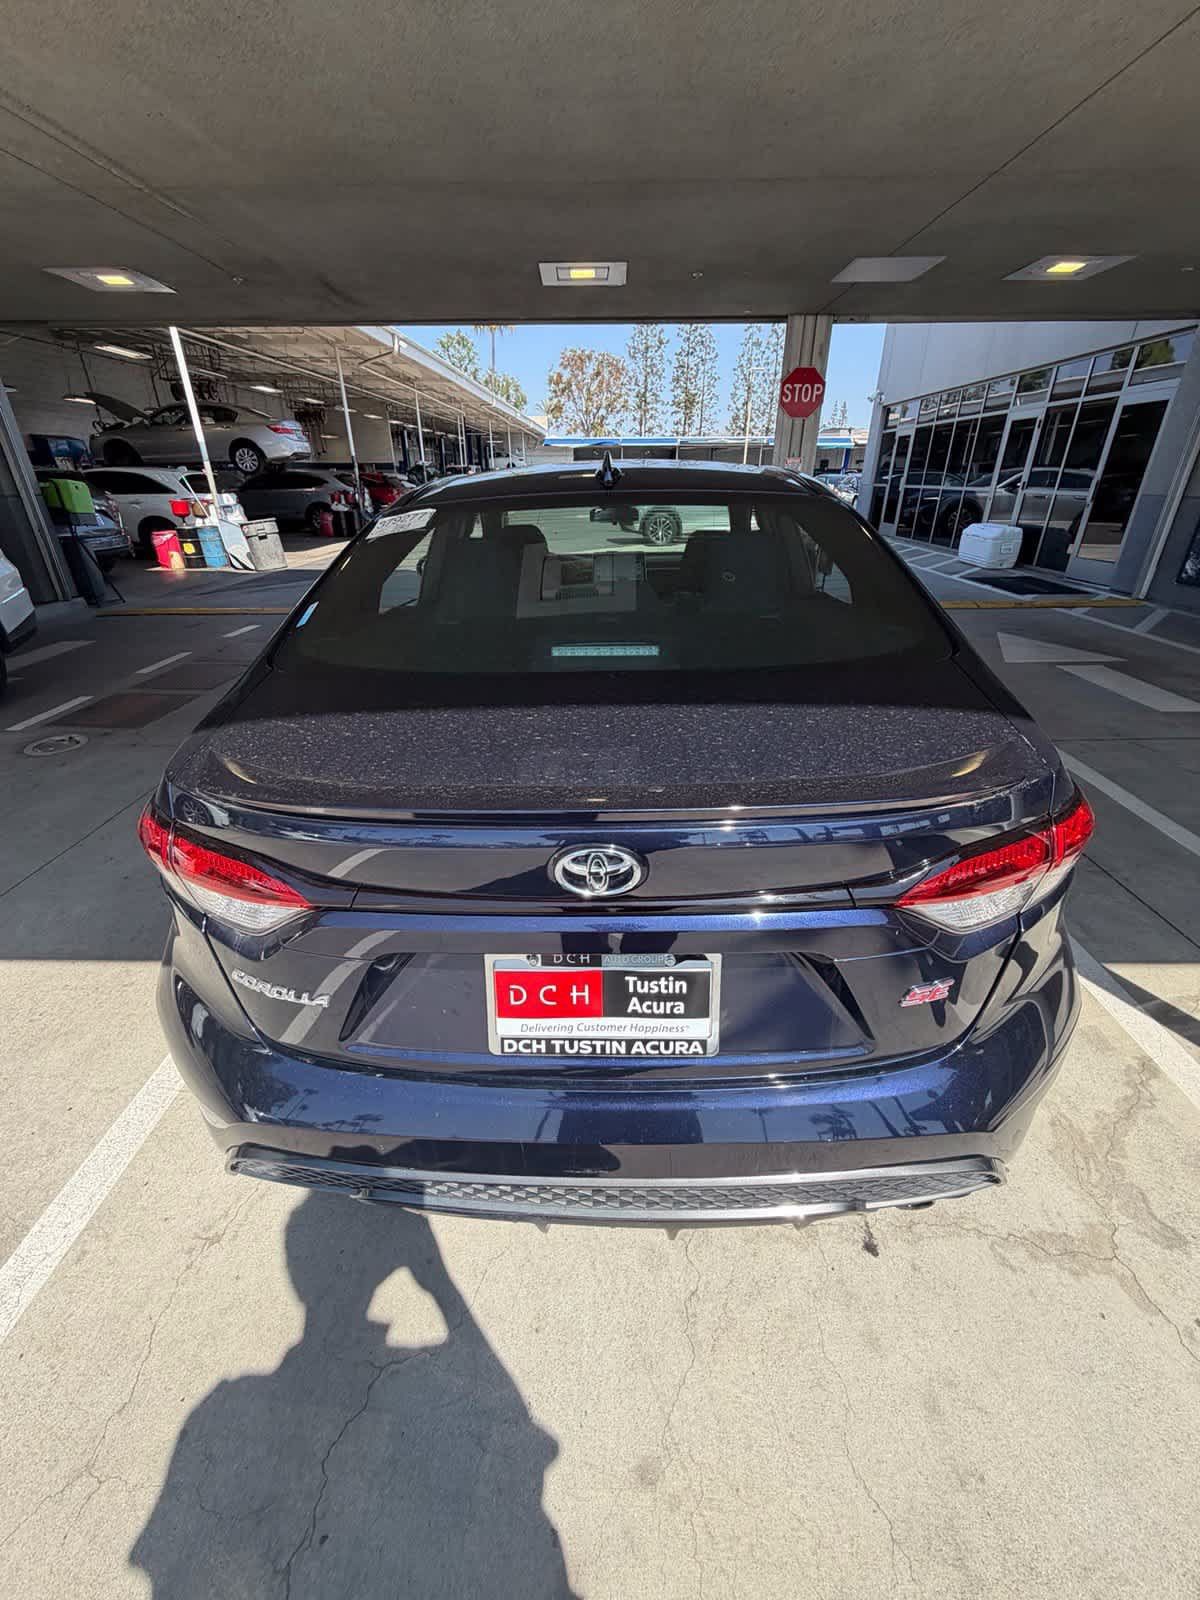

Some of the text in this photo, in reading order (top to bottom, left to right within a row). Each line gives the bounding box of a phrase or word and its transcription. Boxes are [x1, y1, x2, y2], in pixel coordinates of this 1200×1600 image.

[783, 383, 823, 402] STOP
[553, 954, 590, 964] DCH
[231, 968, 330, 1008] COROLLA
[625, 976, 687, 994] Tustin
[509, 985, 590, 1005] DCH
[627, 997, 685, 1014] Acura
[520, 1022, 574, 1034] Delivering
[576, 1022, 627, 1033] Customer
[503, 1039, 704, 1055] DCH TUSTIN ACURA
